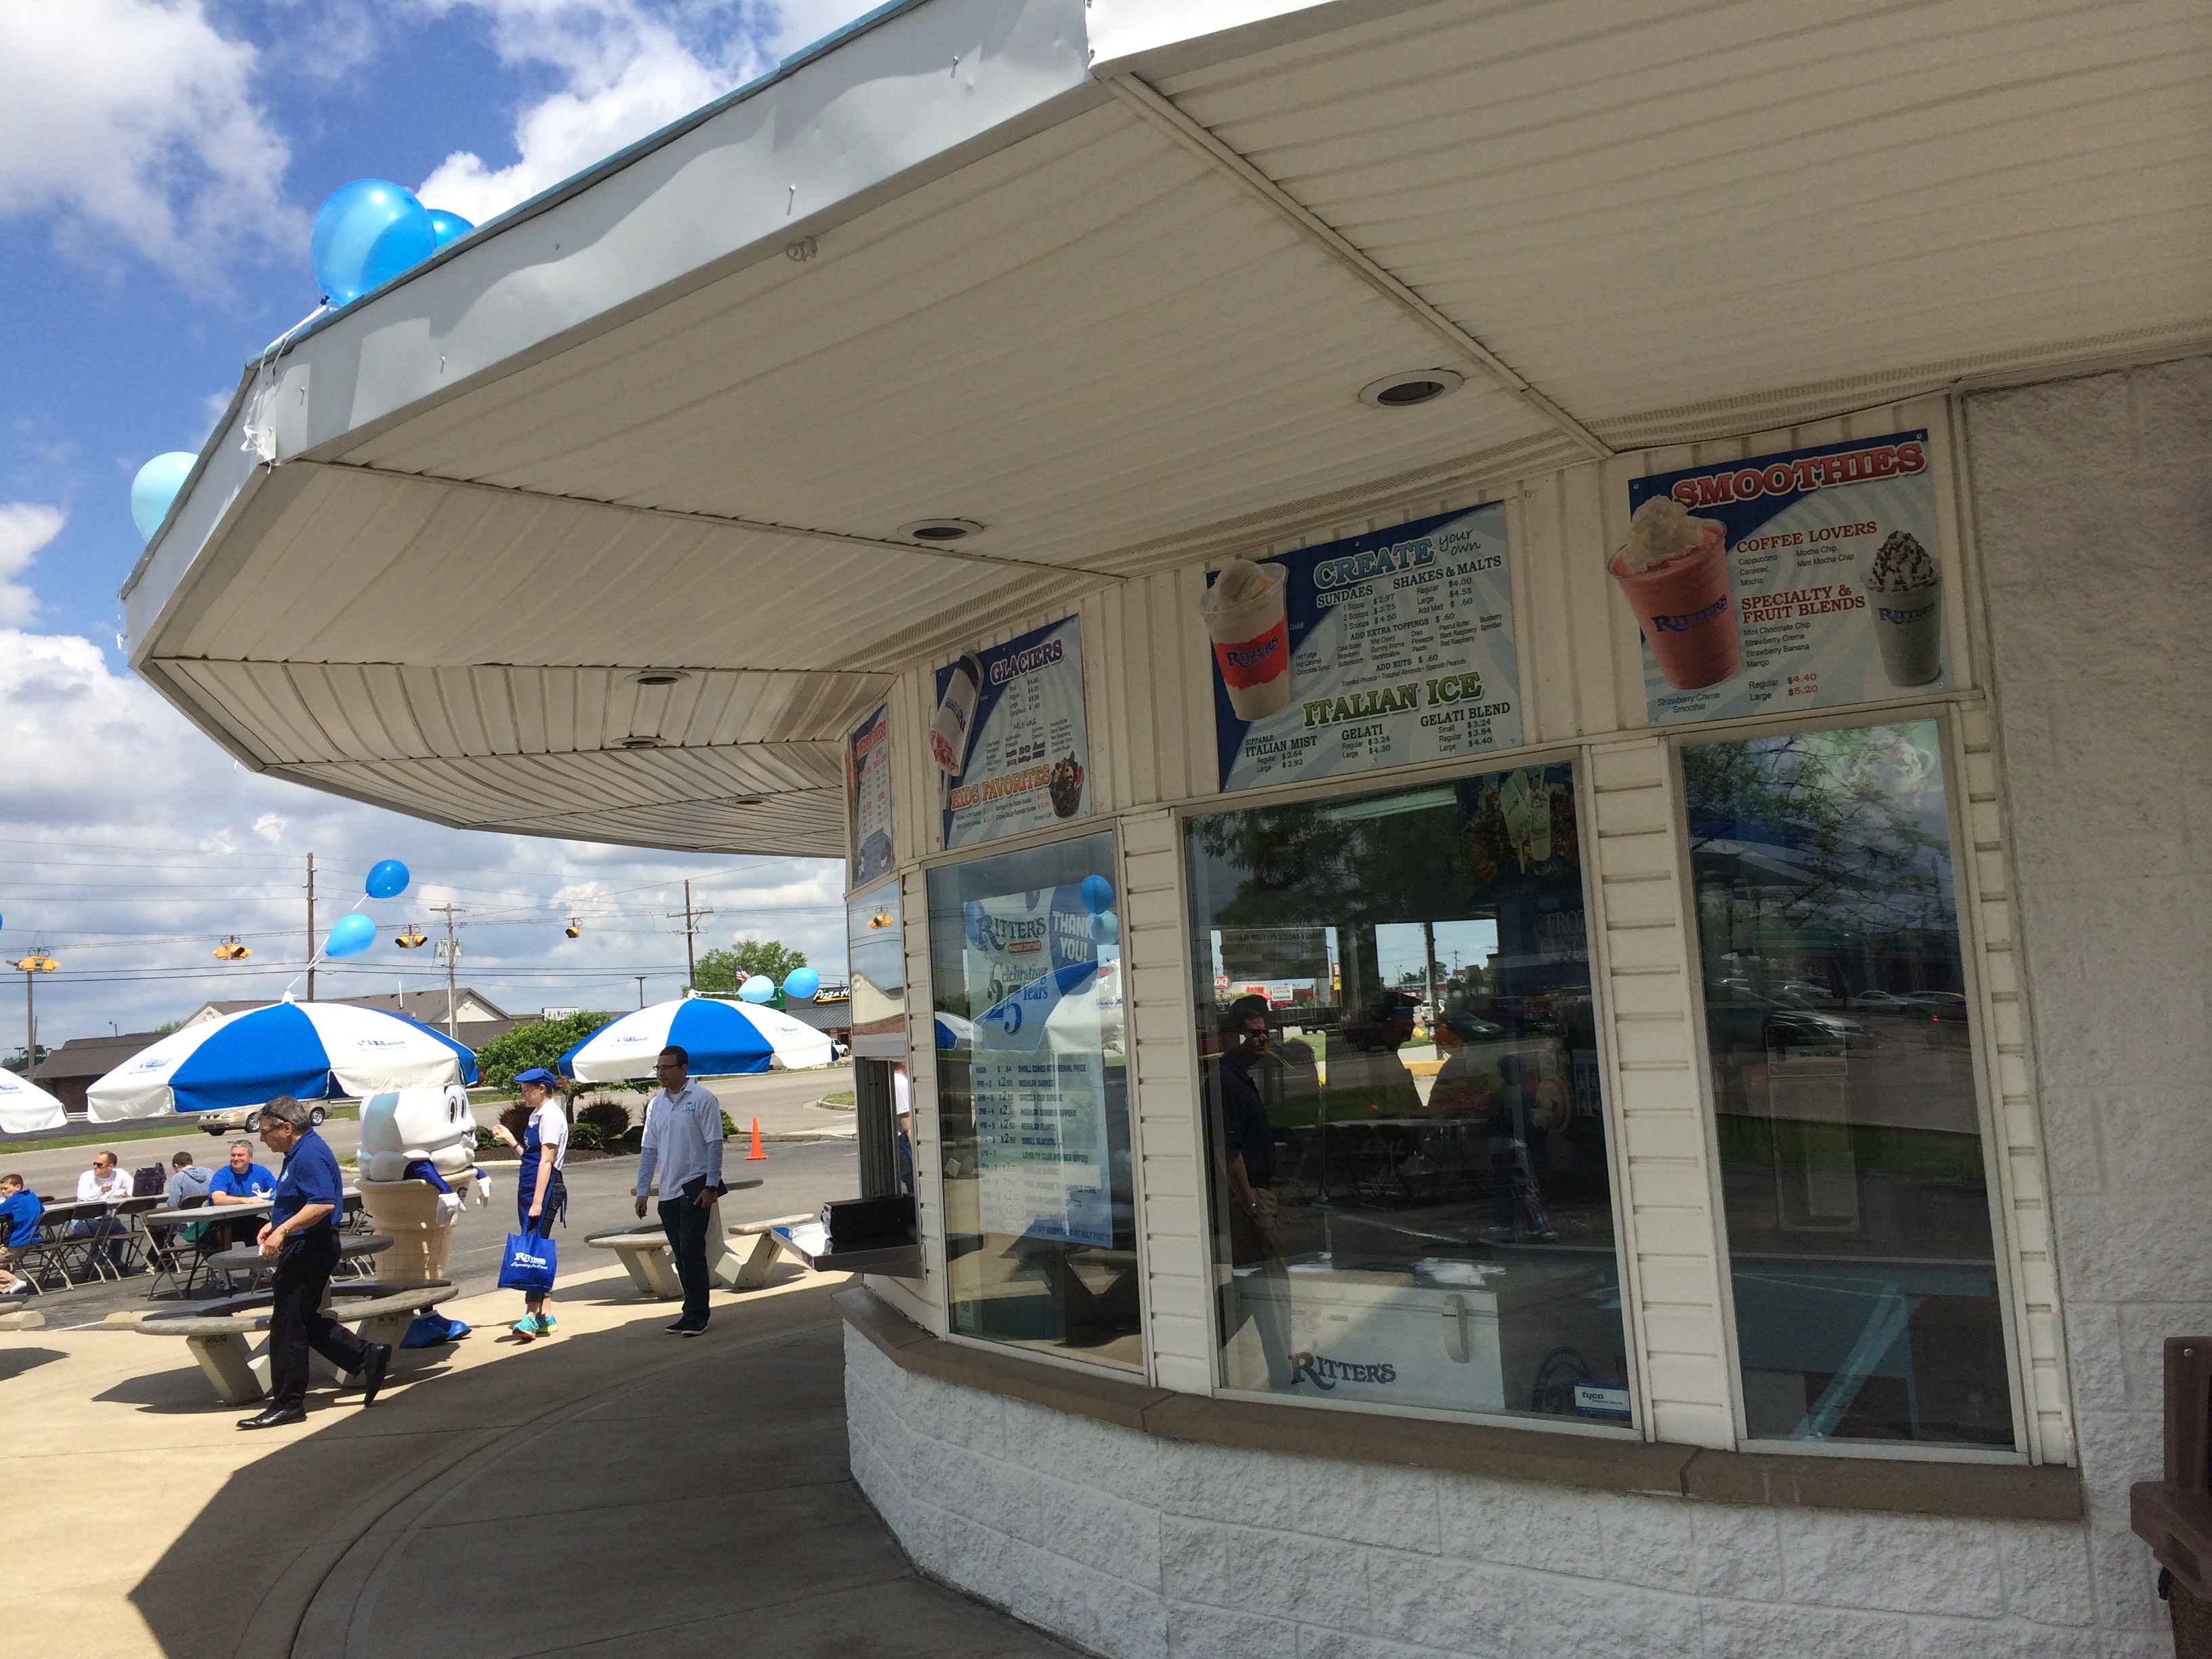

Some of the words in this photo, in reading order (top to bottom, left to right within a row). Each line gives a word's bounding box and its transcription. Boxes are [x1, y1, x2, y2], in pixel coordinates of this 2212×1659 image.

[1673, 443, 1926, 510] SMOOTHIES
[1439, 529, 1473, 552] your
[1736, 533, 1803, 553] COFFEE
[1809, 521, 1877, 542] LOVERS
[1451, 541, 1481, 556] own
[1796, 548, 1819, 556] Mocha
[1314, 539, 1435, 588] CREATE
[1738, 554, 1778, 566] Cappuccino
[1797, 559, 1811, 567] Mint
[1814, 556, 1837, 565] Mocha
[1839, 554, 1854, 562] Chip
[1393, 569, 1443, 590] SHAKES
[1446, 567, 1456, 577] &
[1456, 555, 1502, 575] MALTS
[1317, 584, 1374, 607] SUNDAES
[1742, 586, 1832, 610] SPECIALTY
[1838, 584, 1851, 596] &
[1742, 605, 1793, 623] FRUIT
[1798, 596, 1866, 616] BLENDS
[1351, 631, 1366, 640] ADD
[1367, 626, 1391, 637] EXTRA
[1393, 618, 1429, 632] TOPPINGS
[1759, 624, 1793, 634] Chocolate
[1795, 621, 1811, 630] Chip
[1745, 636, 1780, 647] Strawberry
[1782, 633, 1805, 642] Creme
[1746, 647, 1782, 657] Strawberry
[1783, 644, 1809, 652] Banana
[990, 639, 1063, 684] GLACIERS
[1393, 659, 1412, 668] NUTS
[1746, 658, 1769, 668] Mango
[1749, 678, 1779, 689] Regular
[1787, 673, 1817, 685] $4.40
[1303, 683, 1418, 727] ITALIAN
[1427, 672, 1483, 705] ICE
[1657, 696, 1694, 706] Strawberry
[1696, 692, 1721, 701] Creme
[1750, 691, 1771, 701] Large
[1788, 684, 1818, 697] $5.20
[1420, 710, 1465, 726] GELATI
[1468, 702, 1510, 719] BLEND
[1673, 703, 1706, 713] Smoothie
[1342, 724, 1383, 741] GELATI
[1246, 740, 1287, 757] ITALIAN
[1290, 735, 1317, 749] MIST
[951, 783, 979, 811] KIDS
[982, 764, 1050, 802] FAVORITES
[975, 914, 1046, 952] RITTER'S
[1052, 911, 1094, 939] THANK
[1060, 937, 1088, 962] YOU!
[813, 989, 840, 1000] Pizza
[1288, 1352, 1397, 1390] RITTER'S
[1582, 1391, 1603, 1400] tyco
